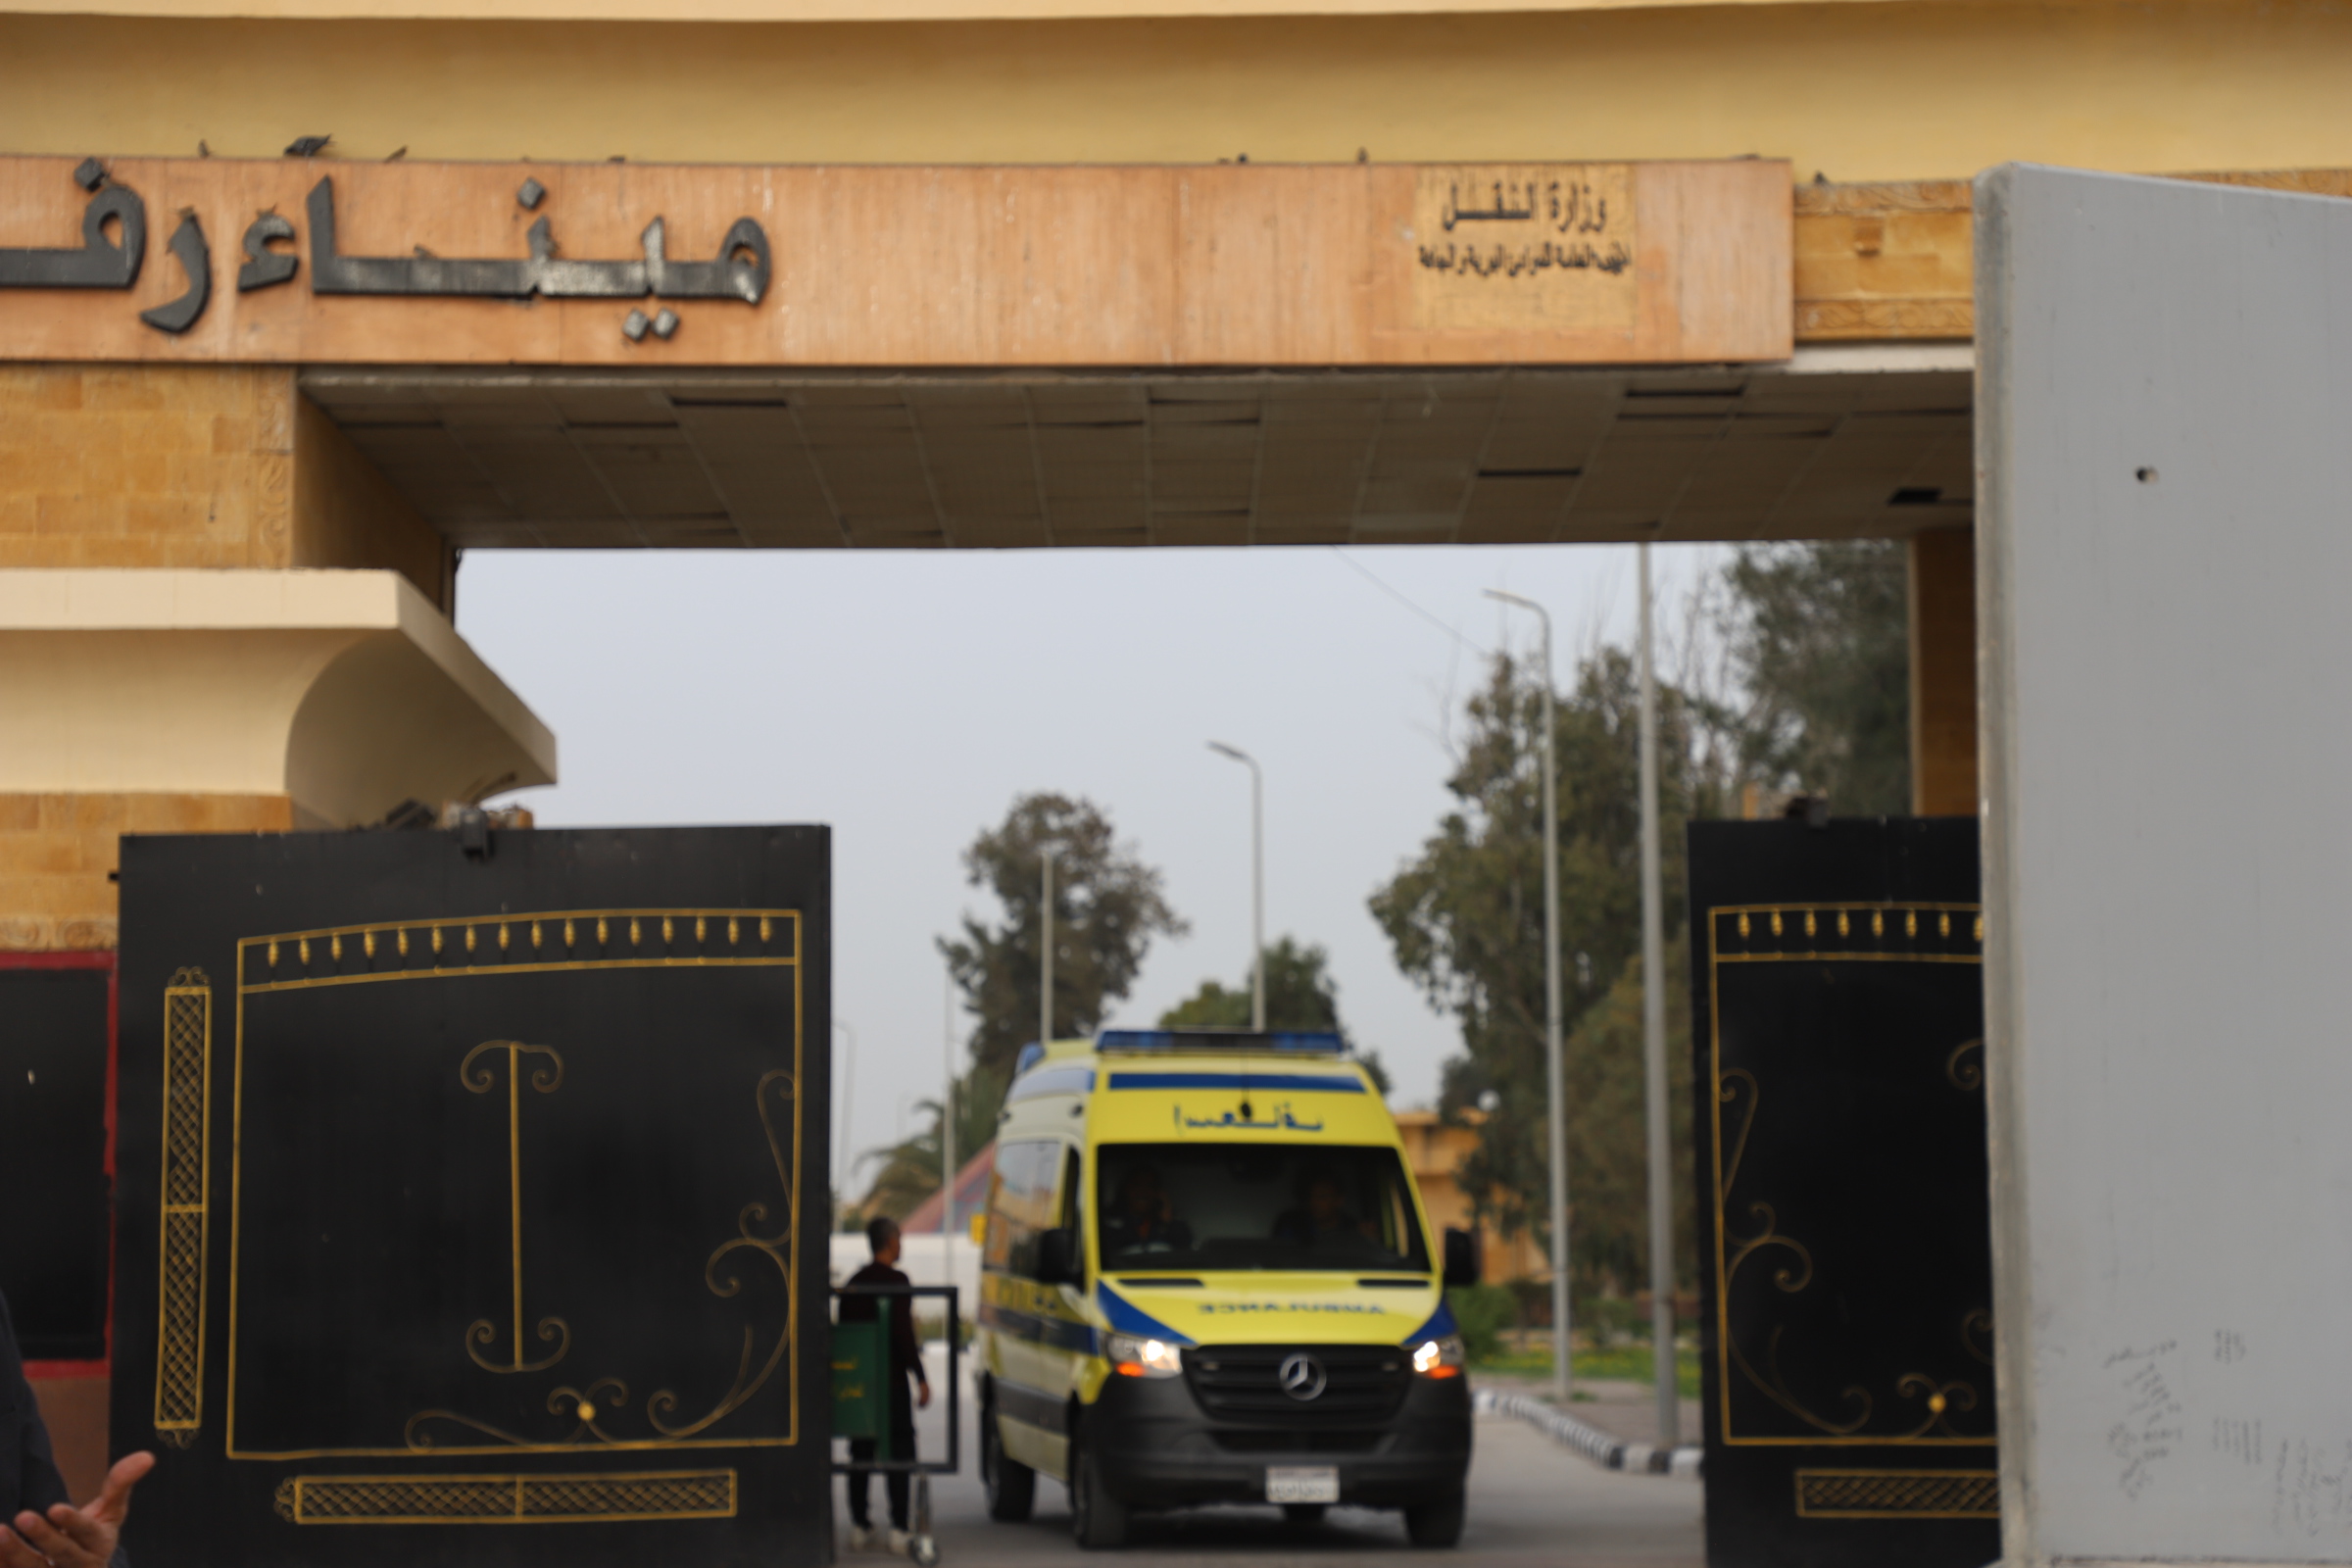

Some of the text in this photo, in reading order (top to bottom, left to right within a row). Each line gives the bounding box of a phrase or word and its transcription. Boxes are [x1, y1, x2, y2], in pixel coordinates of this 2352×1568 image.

[0, 157, 771, 342] ميناء رف
[1442, 180, 1606, 232] وزارة النقل
